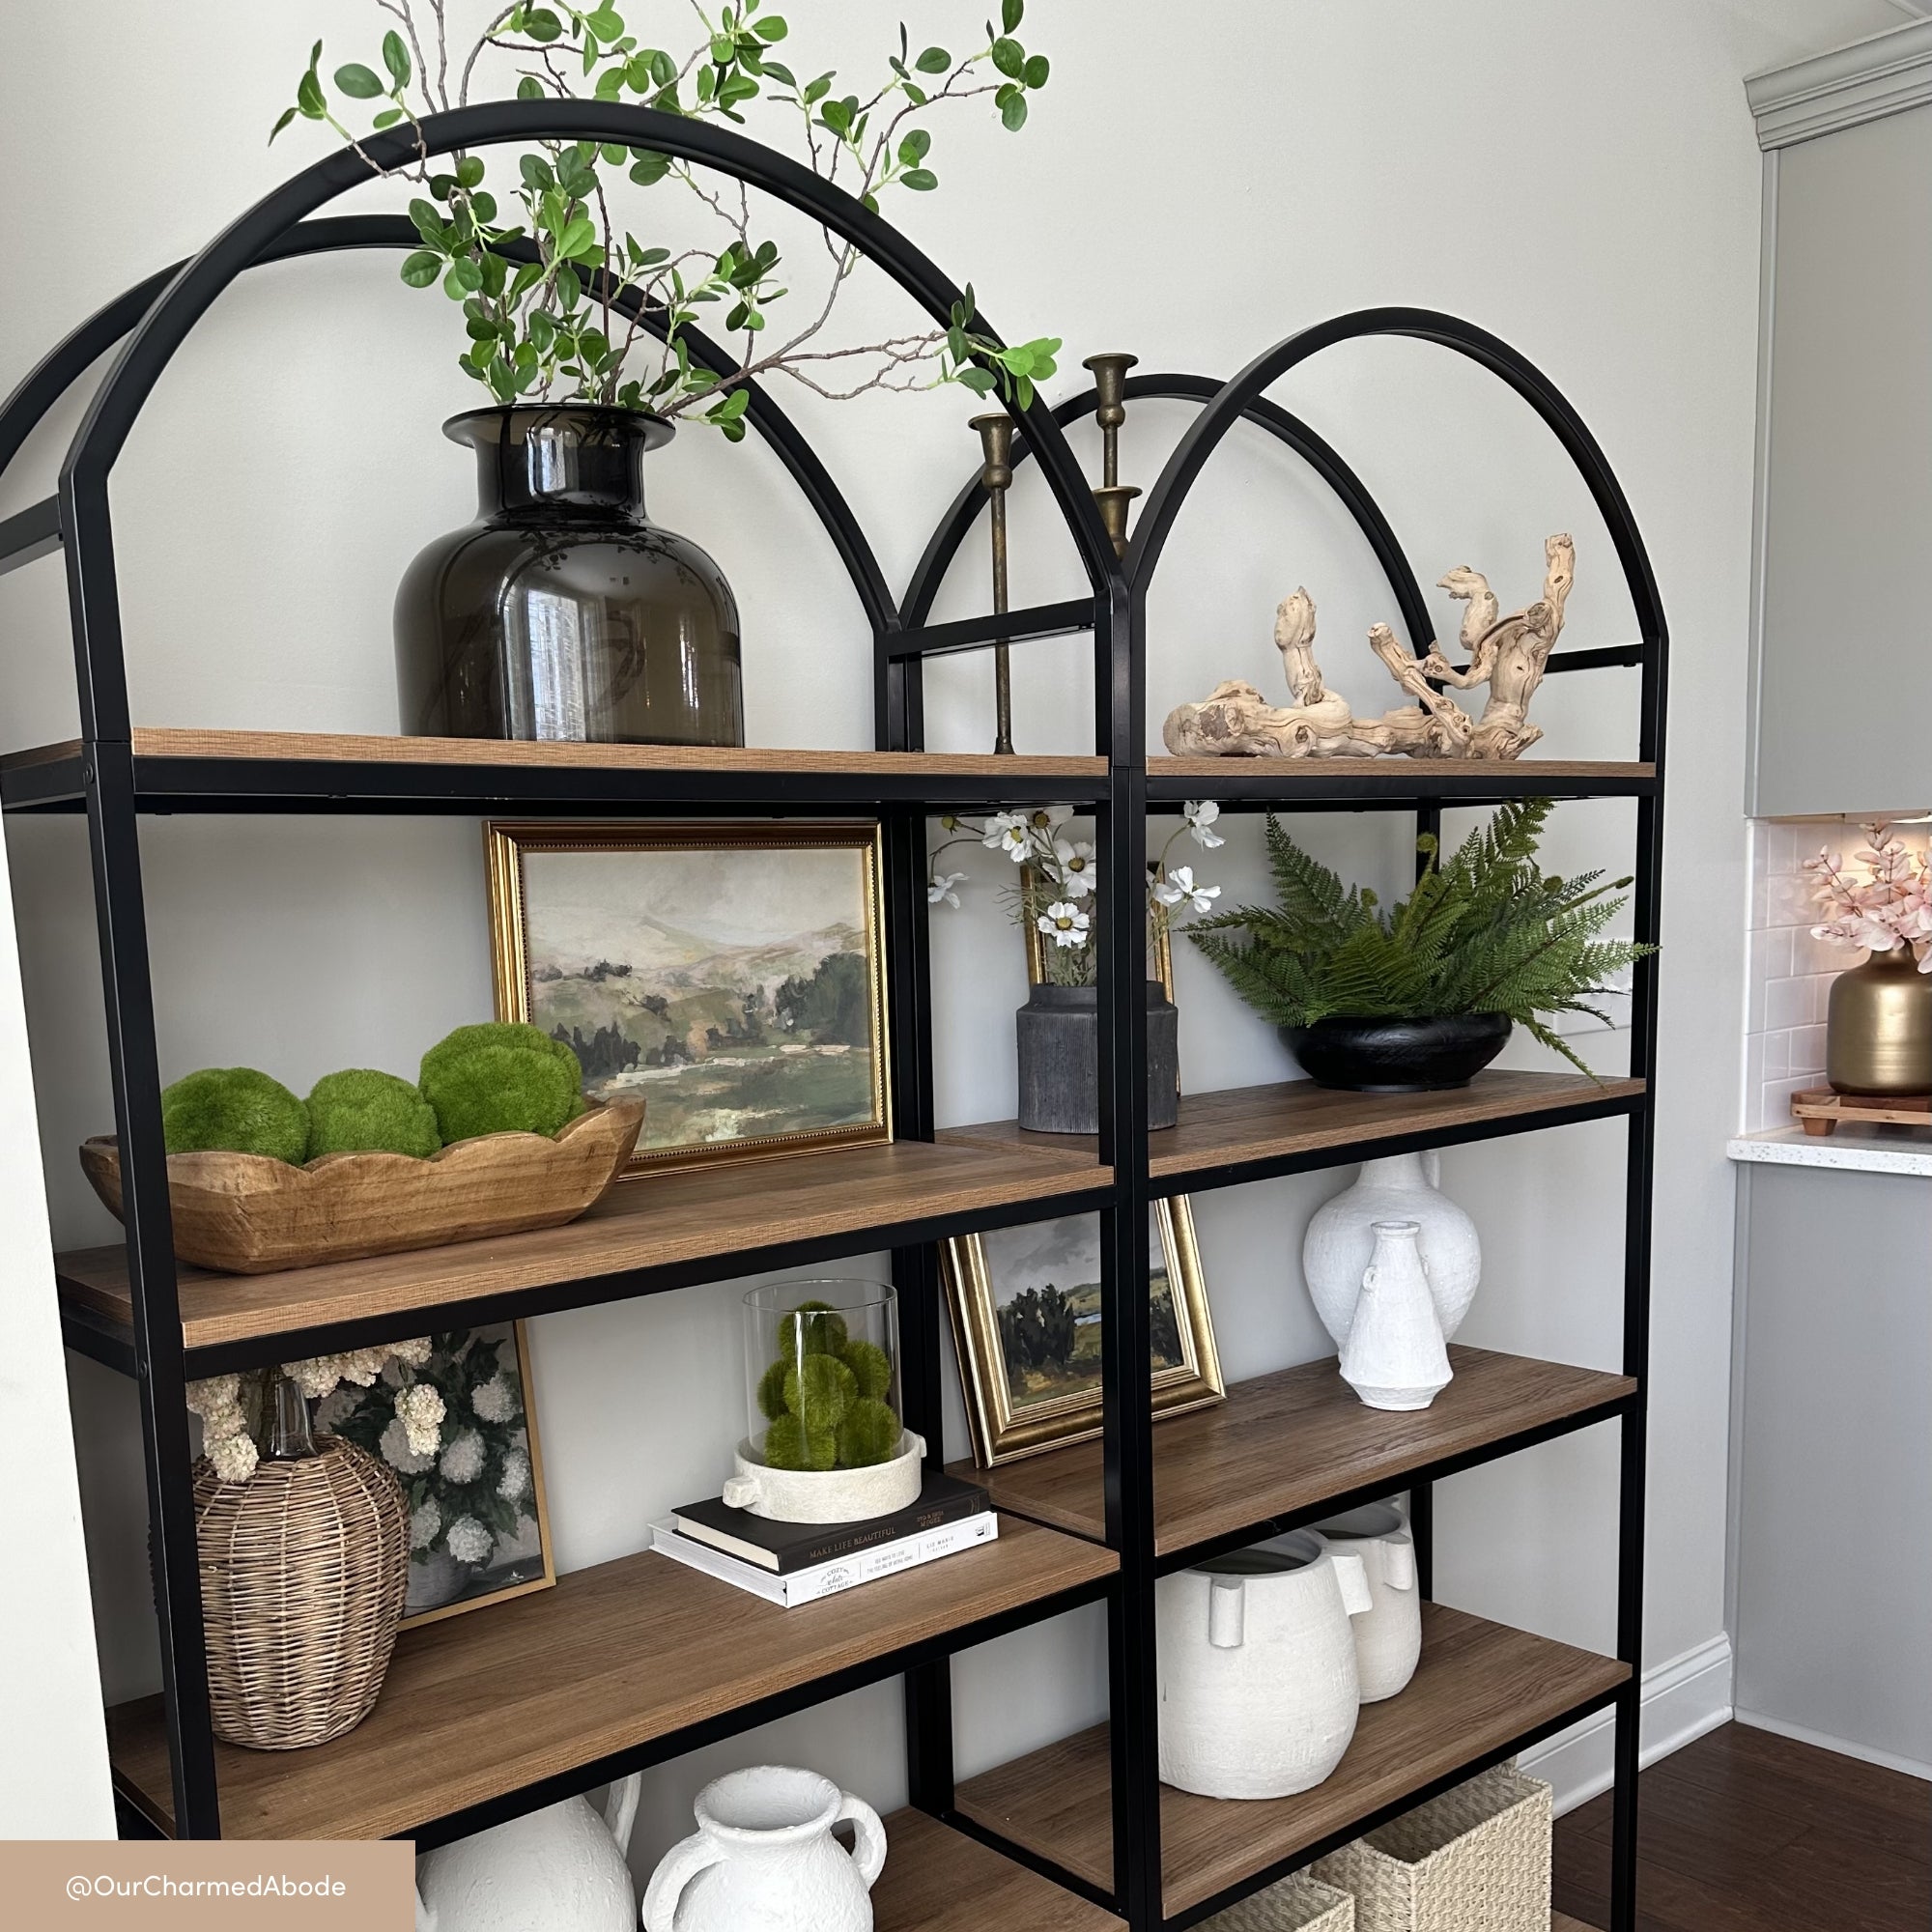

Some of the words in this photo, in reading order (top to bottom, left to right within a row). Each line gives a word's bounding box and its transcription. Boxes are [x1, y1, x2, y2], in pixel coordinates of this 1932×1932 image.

[810, 1546, 832, 1558] MAKE
[834, 1539, 852, 1551] LIFE
[854, 1526, 896, 1546] BEAUTIFUL
[827, 1567, 843, 1577] COZY
[822, 1580, 849, 1593] COTTAGE
